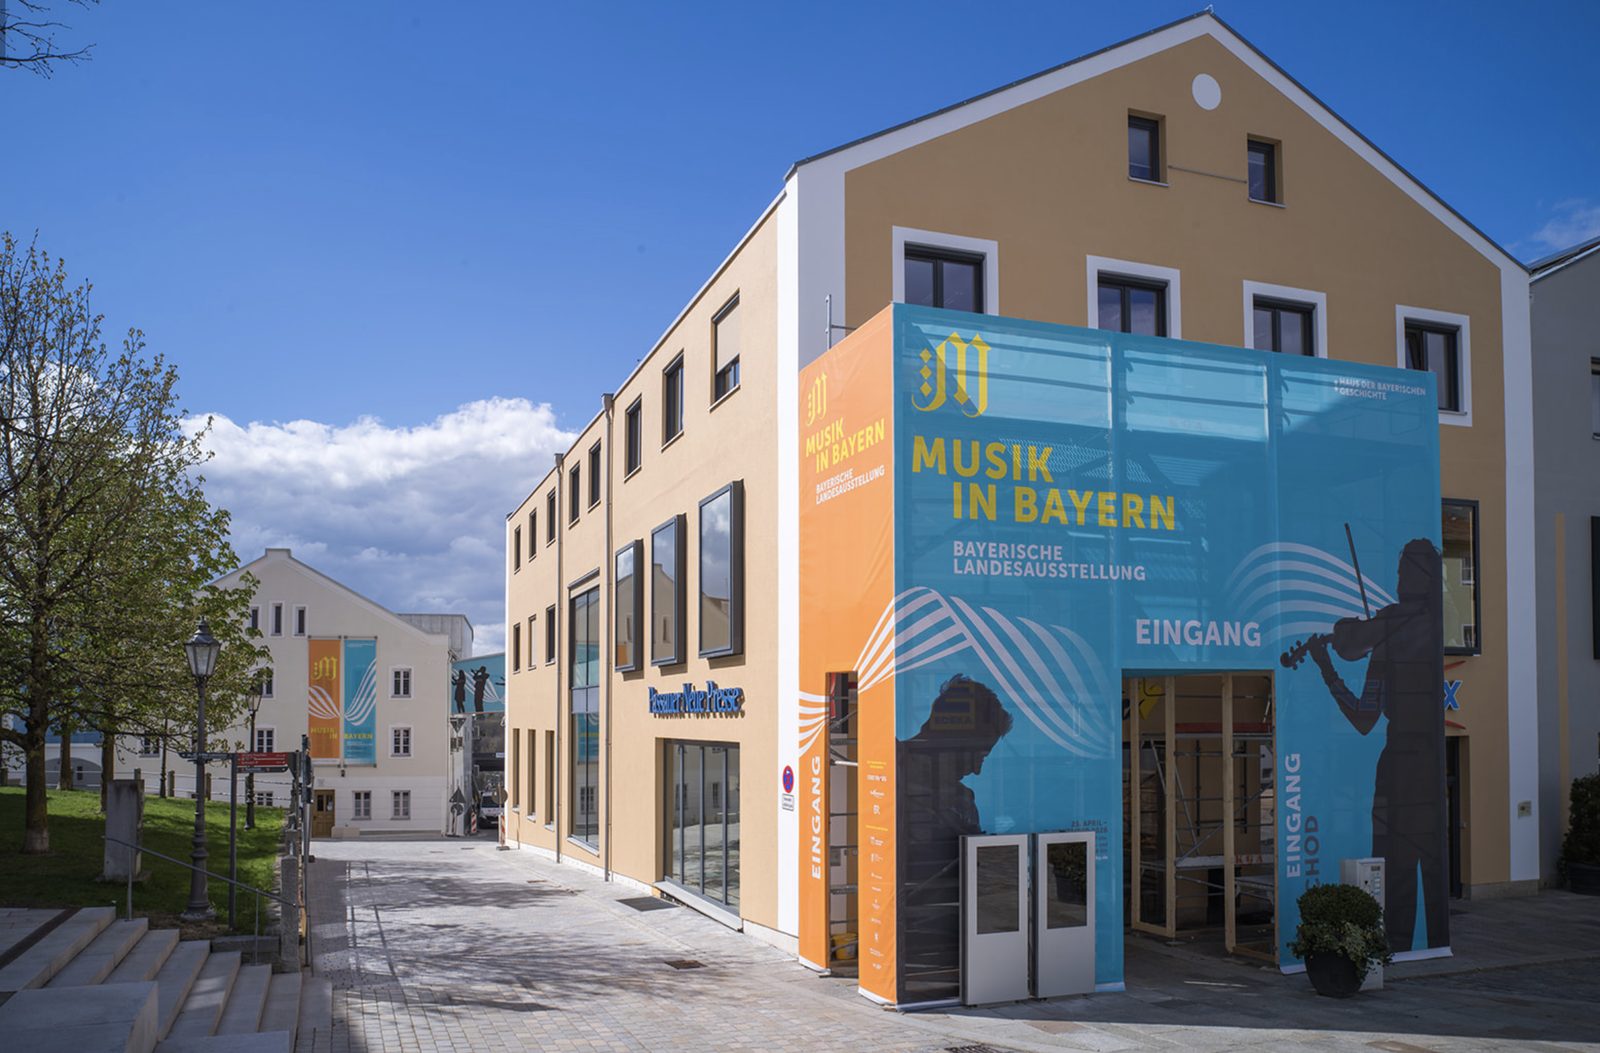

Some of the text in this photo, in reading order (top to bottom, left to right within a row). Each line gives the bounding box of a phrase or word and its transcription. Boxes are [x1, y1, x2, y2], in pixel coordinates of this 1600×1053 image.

[1340, 387, 1387, 400] GESCHICHTE
[1361, 379, 1376, 389] DER
[1377, 382, 1426, 395] BAYERISCHEN
[805, 417, 844, 458] MUSIK
[815, 417, 885, 474] IN BAYERN
[911, 435, 1054, 483] MUSIK
[816, 468, 853, 495] BAYERISCHE
[816, 465, 885, 505] LANDESAUSSTELLUNG
[952, 482, 1175, 531] IN BAYERN
[953, 540, 1063, 561] BAYERISCHE
[953, 558, 1146, 582] LANDESAUSSTELLUNG
[1135, 618, 1262, 648] EINGANG
[682, 682, 706, 713] Neue
[706, 680, 742, 713] Presse
[811, 755, 821, 881] EINGANG
[1285, 753, 1301, 878] EINGANG
